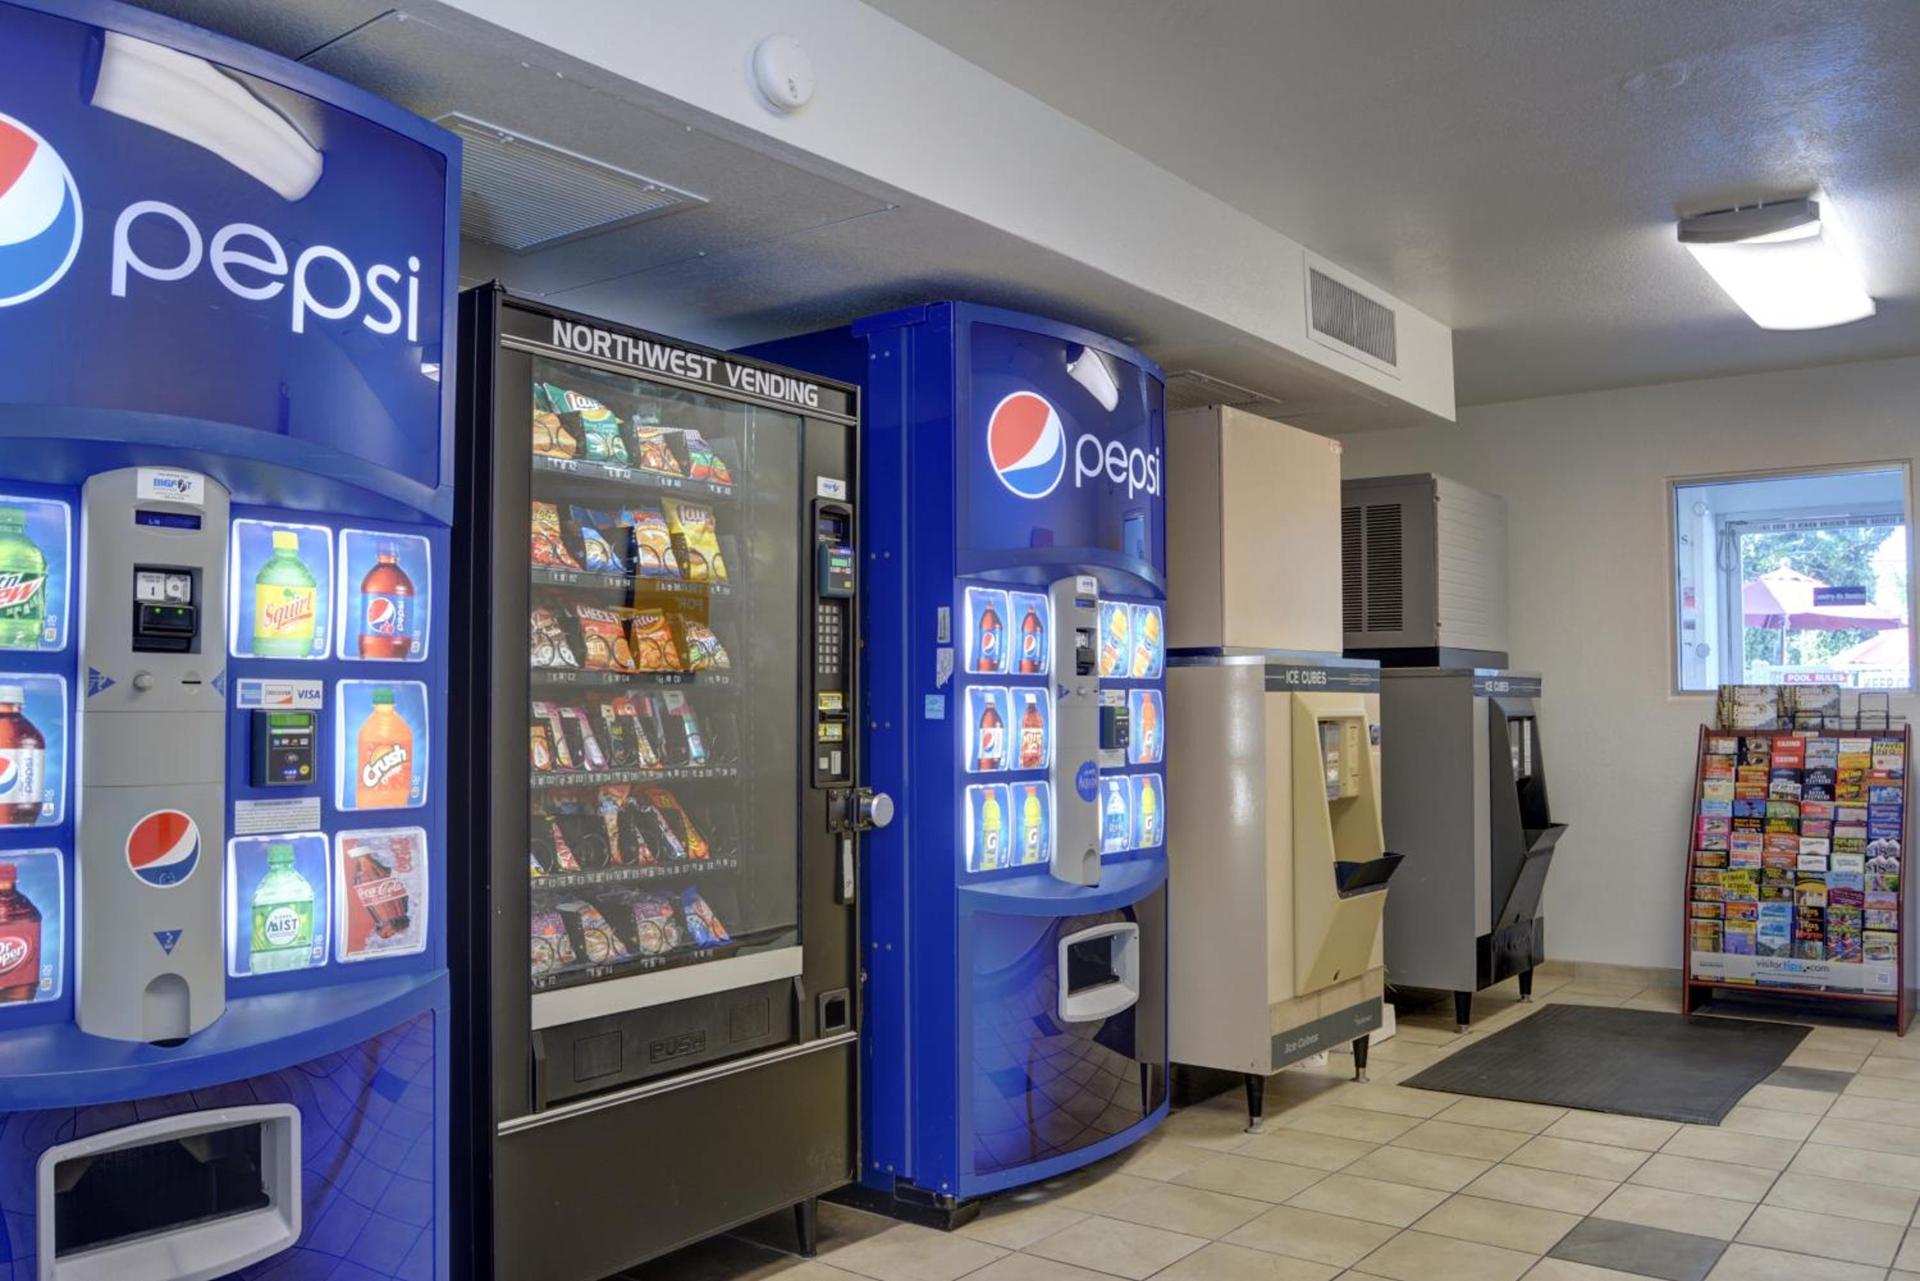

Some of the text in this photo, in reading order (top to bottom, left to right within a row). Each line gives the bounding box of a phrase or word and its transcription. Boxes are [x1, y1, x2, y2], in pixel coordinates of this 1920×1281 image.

[111, 200, 420, 342] pepsi
[553, 319, 819, 408] NORTHWEST VENDING
[1075, 433, 1160, 499] pepsi
[264, 592, 313, 630] Squirt
[298, 688, 321, 700] VISA
[1286, 670, 1327, 685] ICE CUBES
[24, 758, 34, 795] pepsi
[363, 744, 407, 788] Crush
[267, 918, 298, 933] MIST
[654, 1032, 704, 1057] PUSH
